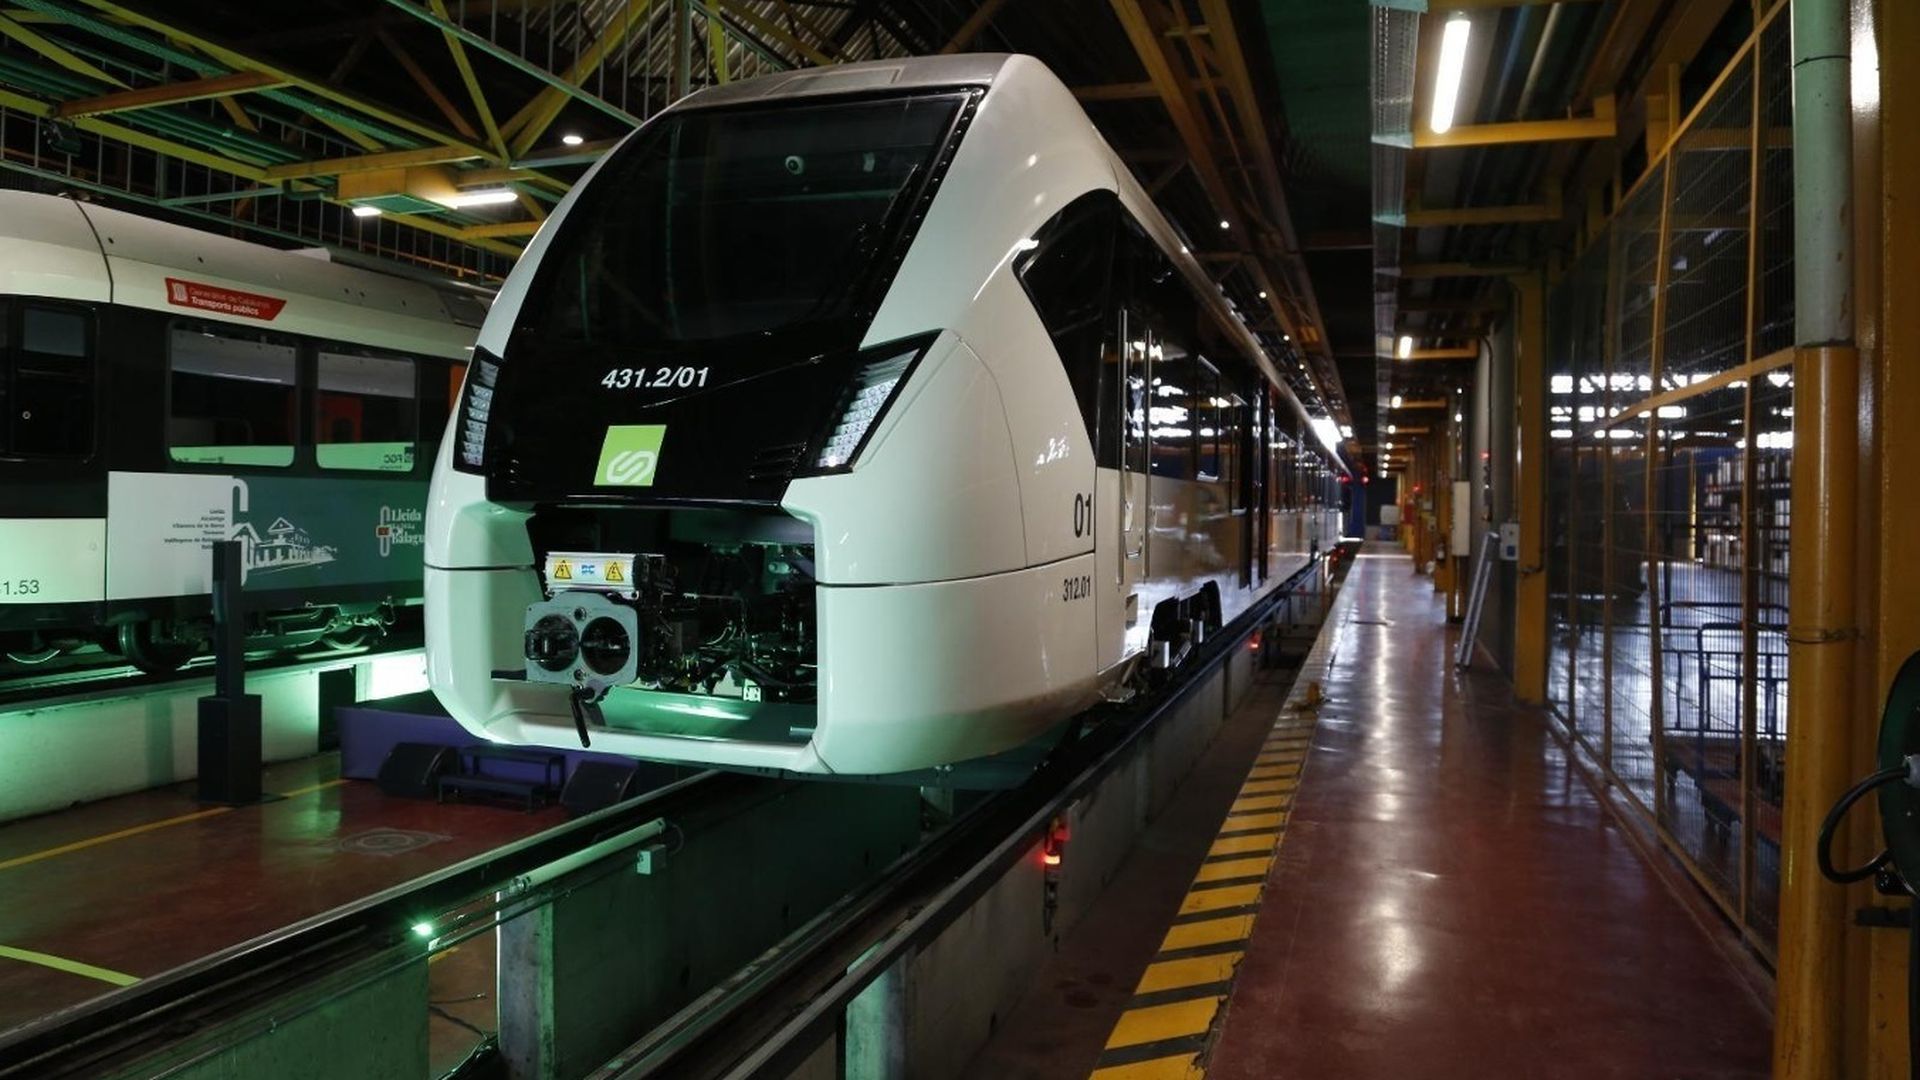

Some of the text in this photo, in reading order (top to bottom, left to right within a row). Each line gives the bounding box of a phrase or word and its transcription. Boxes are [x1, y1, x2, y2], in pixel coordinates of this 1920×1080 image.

[191, 296, 231, 310] Transports
[601, 366, 709, 389] 431.2/01
[392, 508, 421, 521] Lleida
[1074, 493, 1092, 538] 01
[392, 531, 425, 546] Balagu
[0, 579, 40, 595] 1.53
[1062, 575, 1091, 602] 312.01
